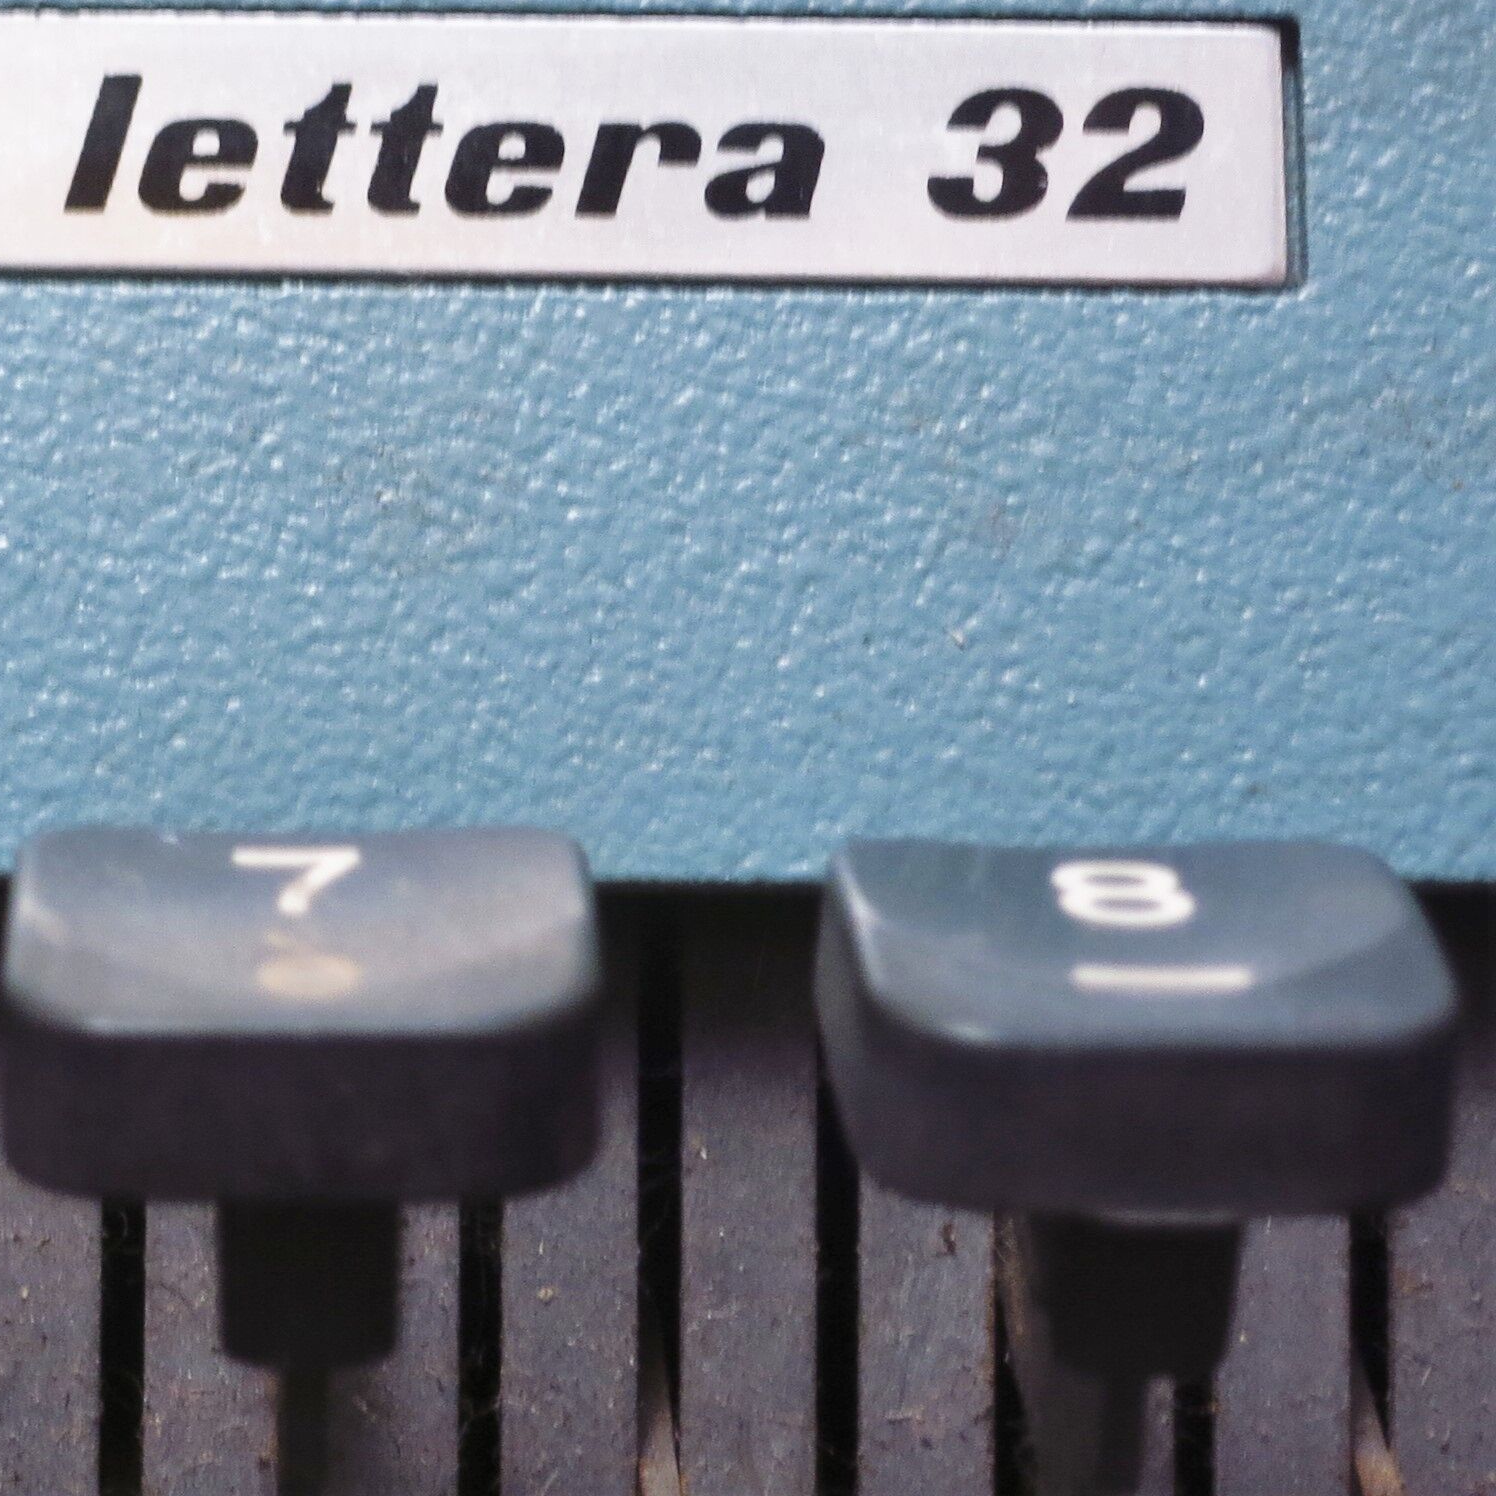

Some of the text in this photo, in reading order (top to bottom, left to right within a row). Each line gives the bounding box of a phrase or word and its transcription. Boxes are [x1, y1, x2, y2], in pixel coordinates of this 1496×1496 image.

[64, 73, 827, 221] lettera
[926, 86, 1206, 222] 32
[232, 847, 360, 916] 7
[1051, 861, 1195, 927] 8
